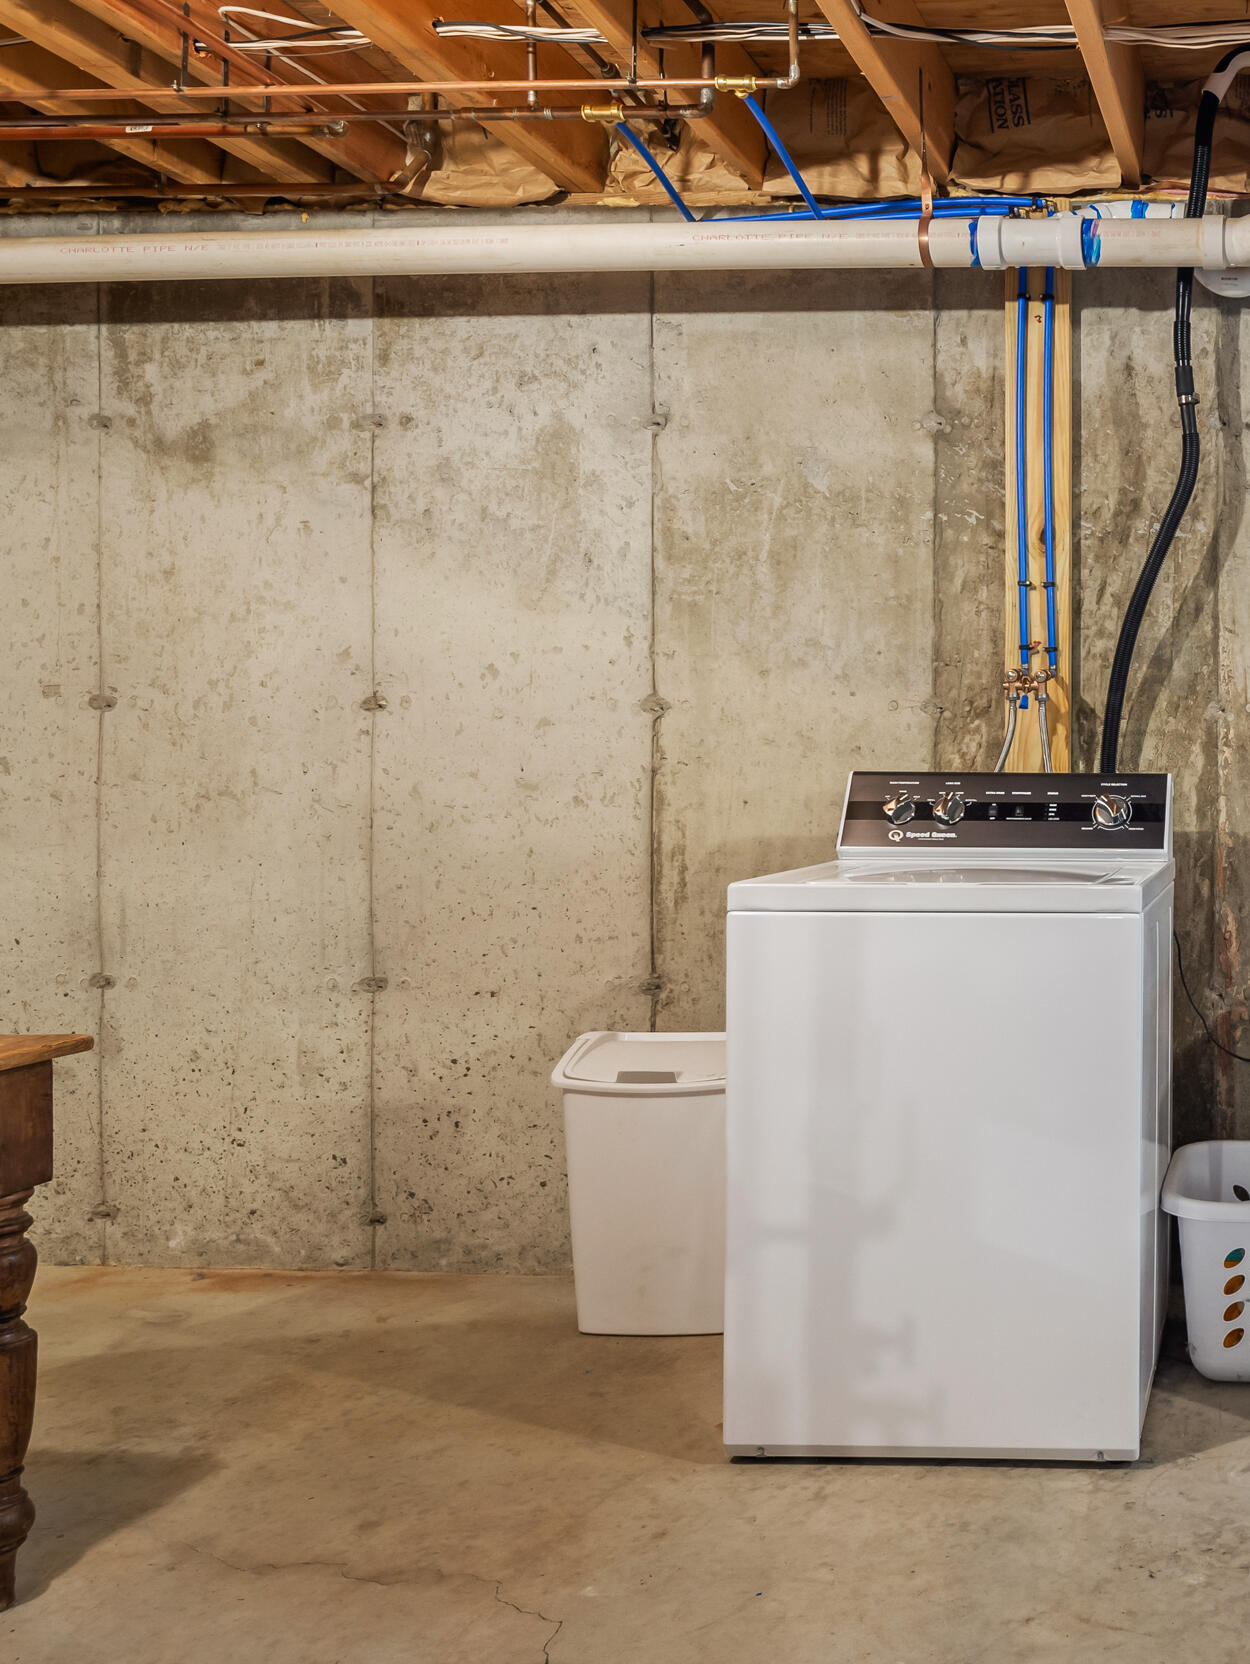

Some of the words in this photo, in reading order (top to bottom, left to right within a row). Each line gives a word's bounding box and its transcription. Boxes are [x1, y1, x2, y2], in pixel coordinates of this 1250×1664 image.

[691, 233, 769, 241] CHARLOTTE
[777, 232, 808, 240] PIPE
[59, 246, 136, 255] CHARLOTTE
[143, 245, 177, 253] PIPE
[905, 831, 930, 840] Speed
